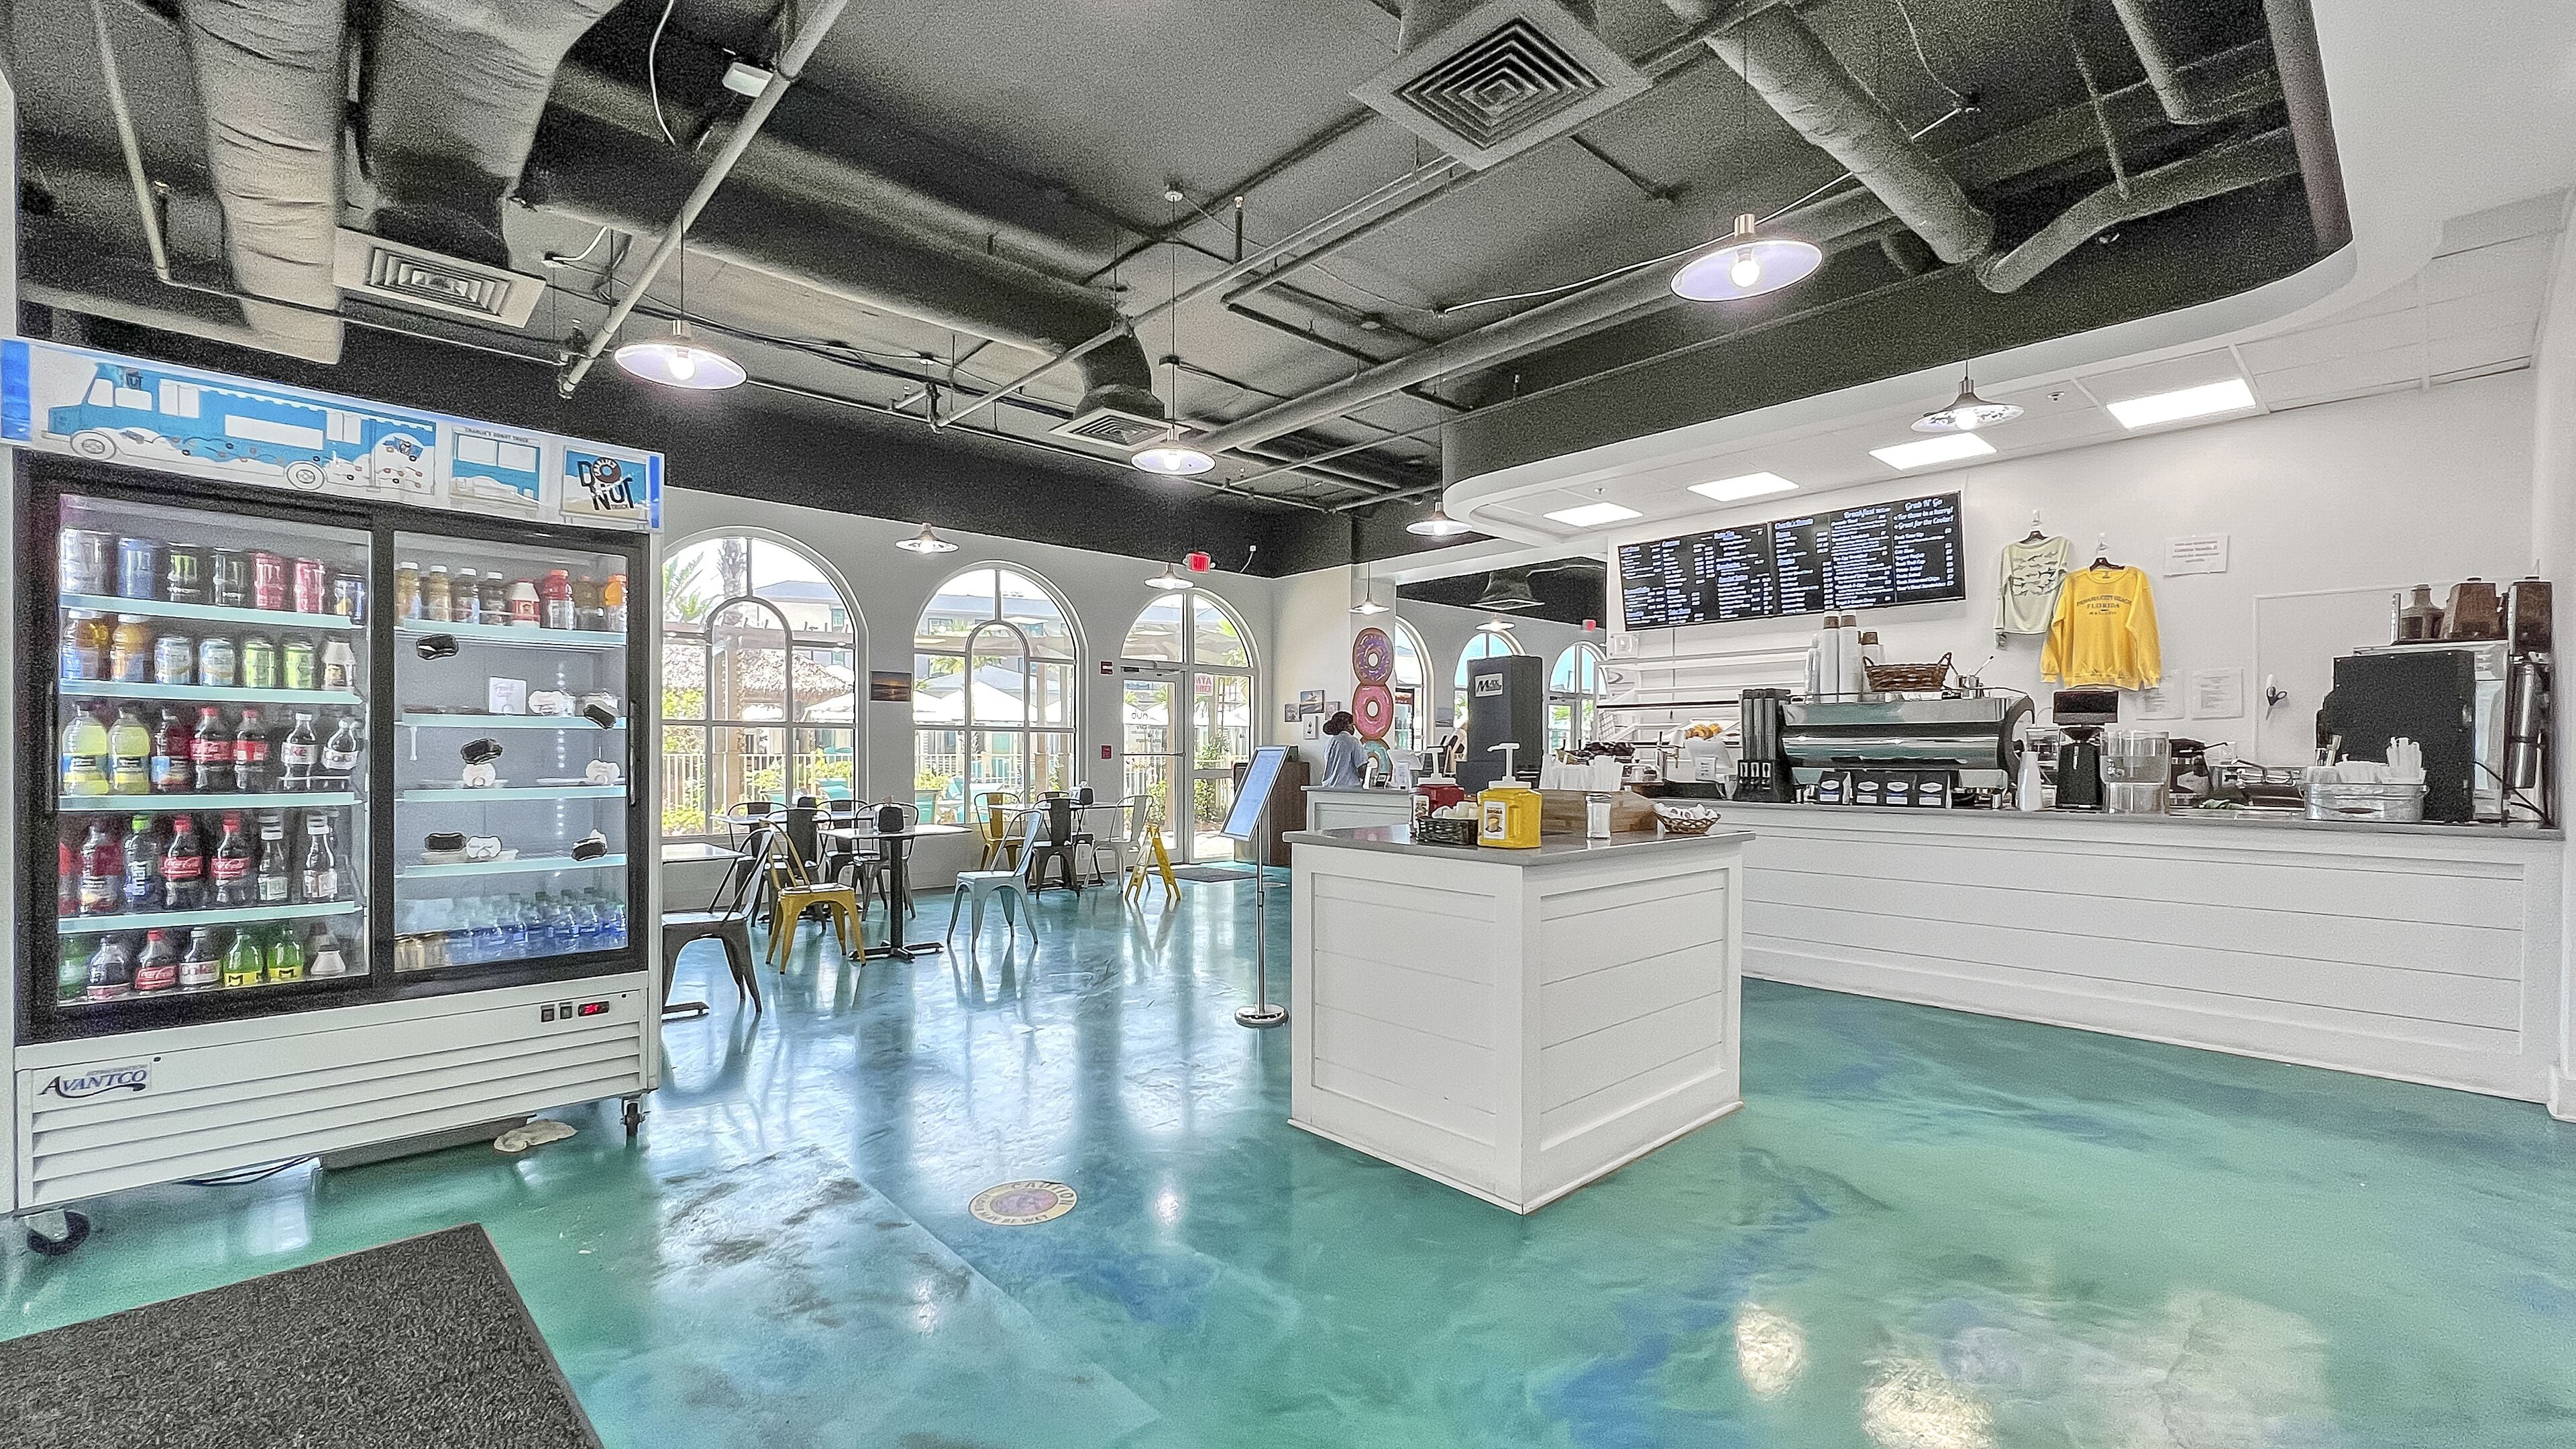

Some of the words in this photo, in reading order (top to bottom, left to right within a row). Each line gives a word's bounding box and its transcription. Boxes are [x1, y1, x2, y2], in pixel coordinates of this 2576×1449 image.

[1904, 502, 1923, 511] Grab
[1932, 498, 1943, 507] Go
[37, 1069, 148, 1098] AVANTCO
